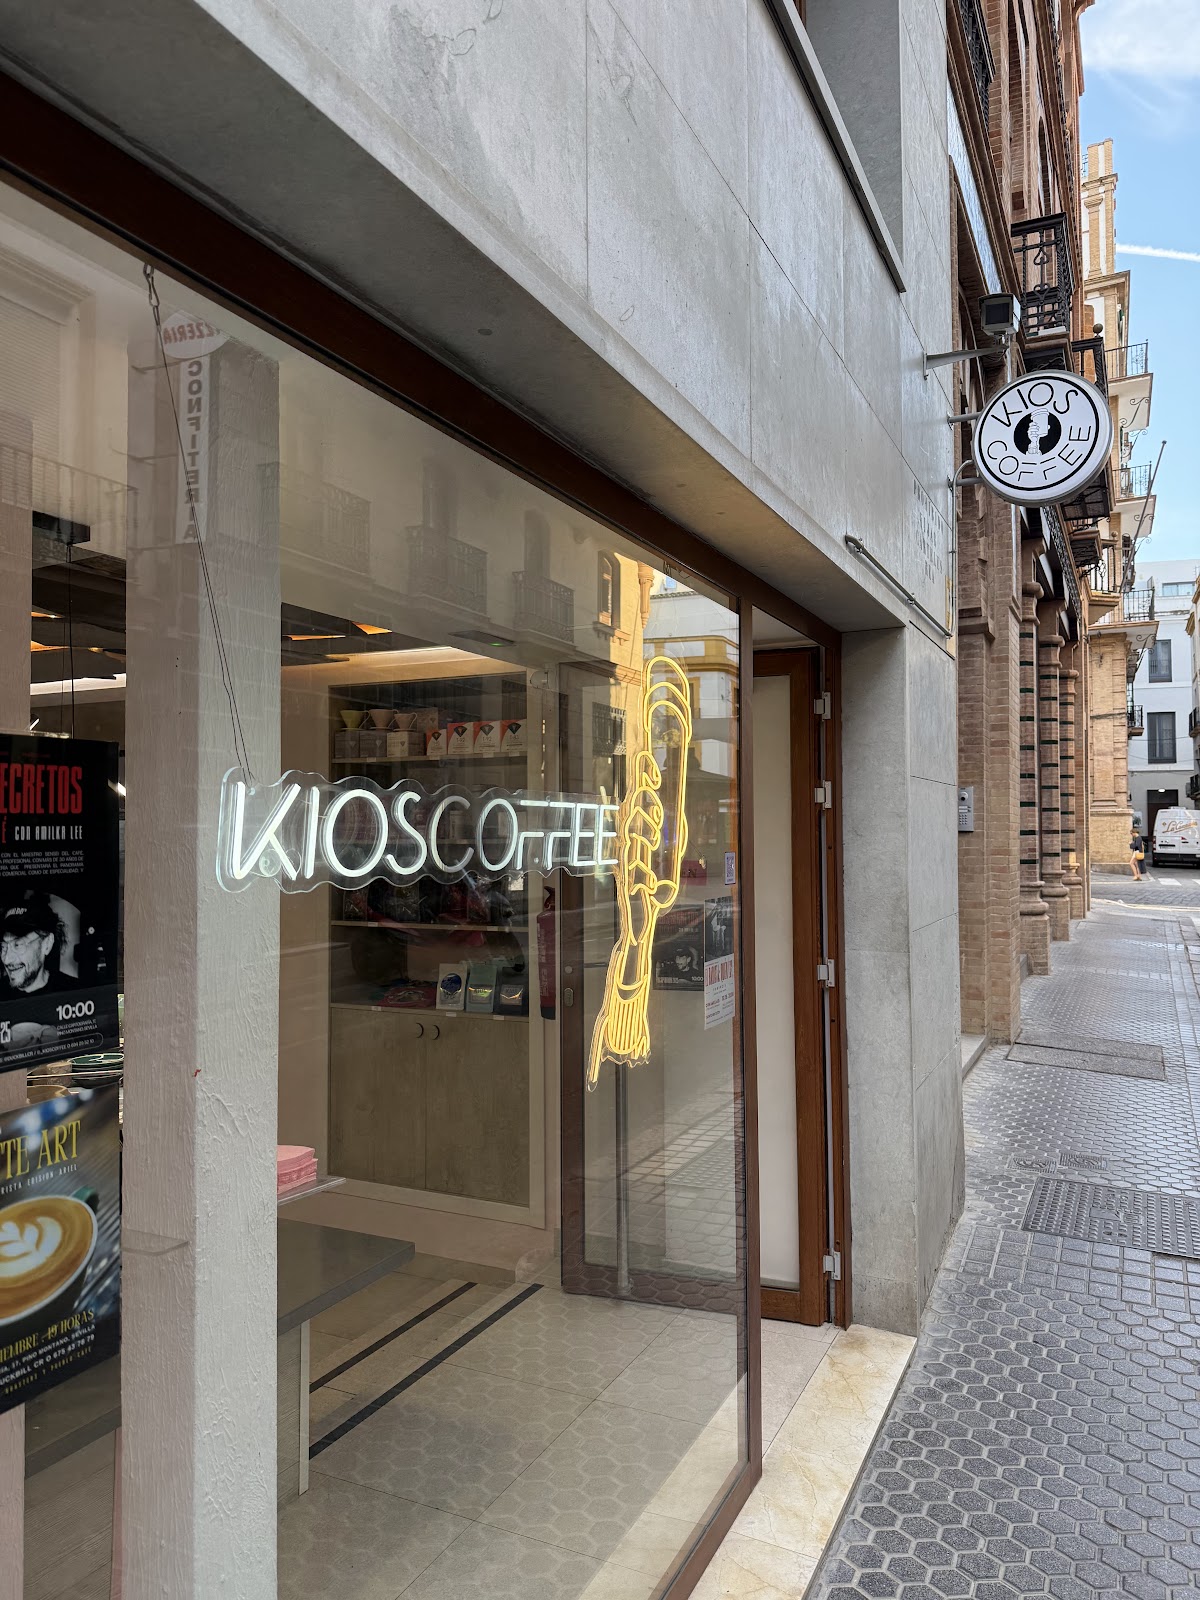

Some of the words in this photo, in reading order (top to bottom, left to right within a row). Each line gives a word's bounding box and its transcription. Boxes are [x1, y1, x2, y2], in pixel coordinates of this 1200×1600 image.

[990, 381, 1079, 428] KIOS
[987, 425, 1092, 482] COFFEE
[15, 826, 31, 840] CON
[35, 825, 66, 840] AMILKA
[70, 825, 83, 840] LEE
[56, 1000, 95, 1021] 10:00
[37, 1120, 81, 1169] ART
[60, 1307, 95, 1334] HORAS
